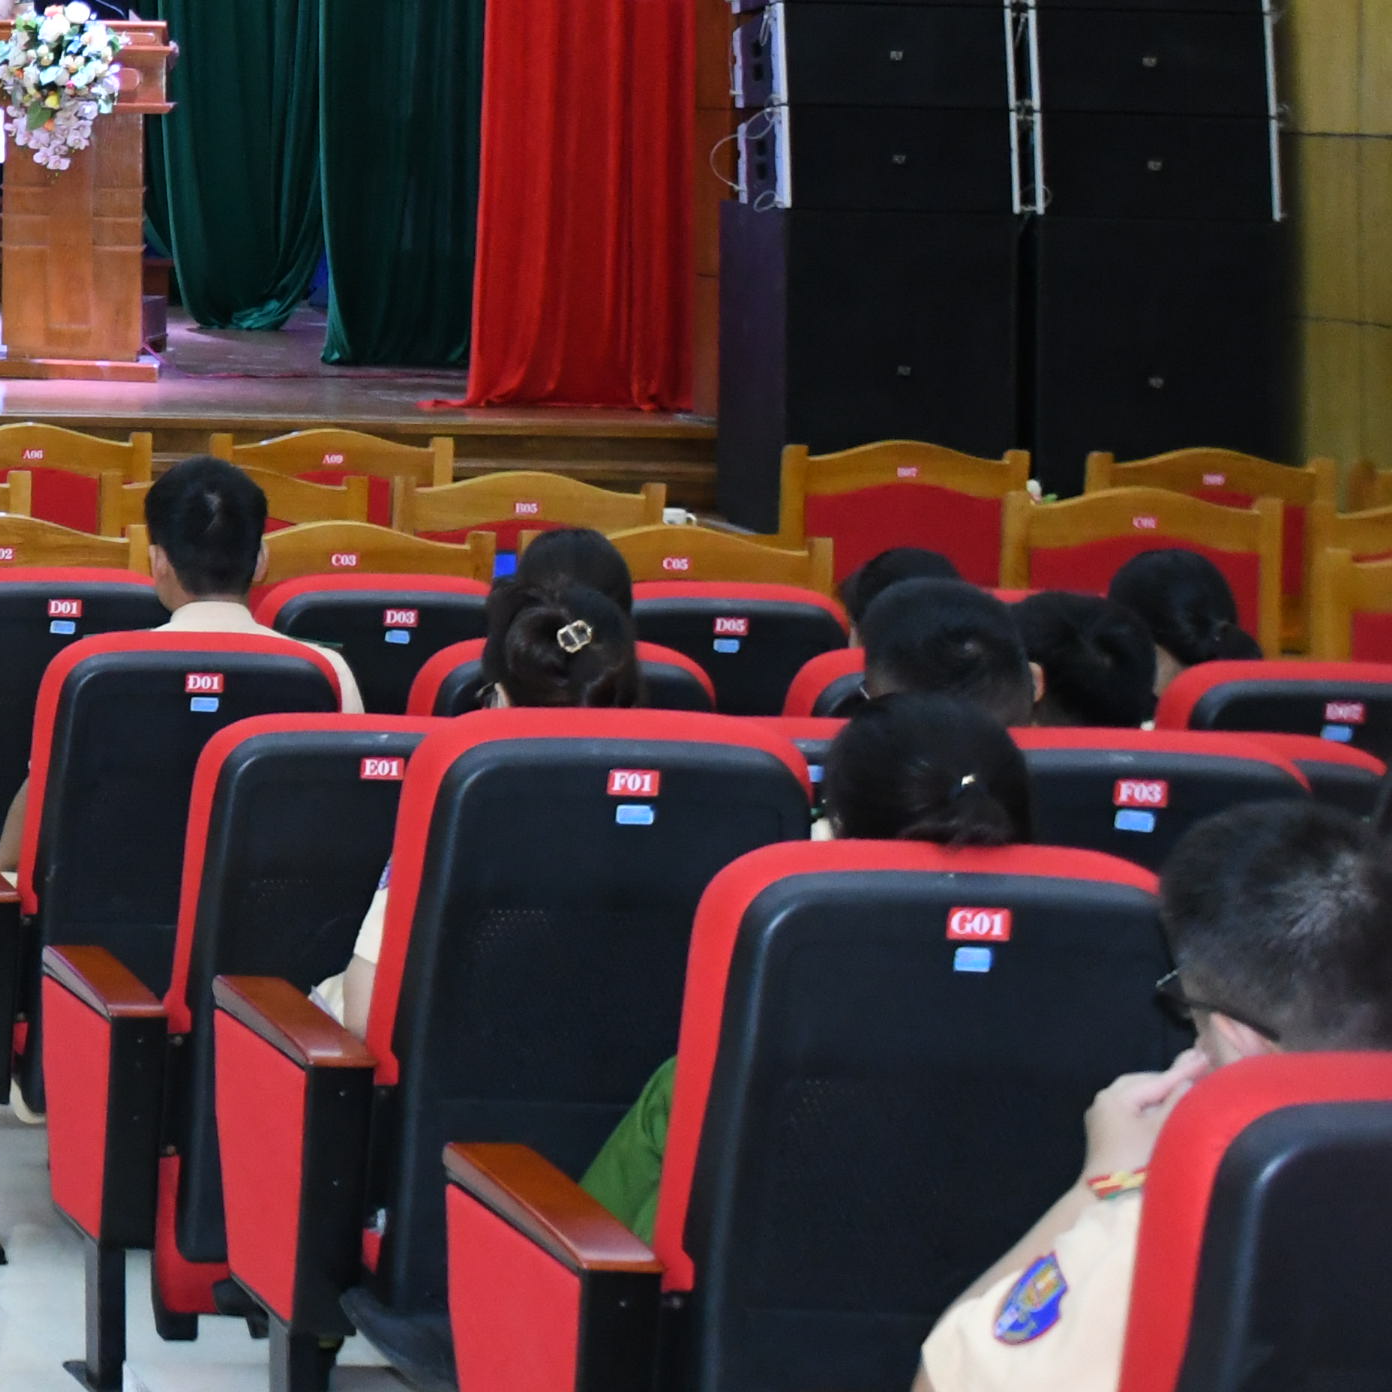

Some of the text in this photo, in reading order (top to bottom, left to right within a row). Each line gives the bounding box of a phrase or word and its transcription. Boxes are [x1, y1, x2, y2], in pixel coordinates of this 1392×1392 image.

[331, 553, 357, 567] C03
[662, 557, 689, 571] C05
[49, 600, 78, 615] D01
[385, 610, 416, 625] D03
[364, 759, 398, 777] E01
[612, 772, 651, 792] F01
[1119, 781, 1162, 803] F03
[950, 910, 1003, 936] G01
